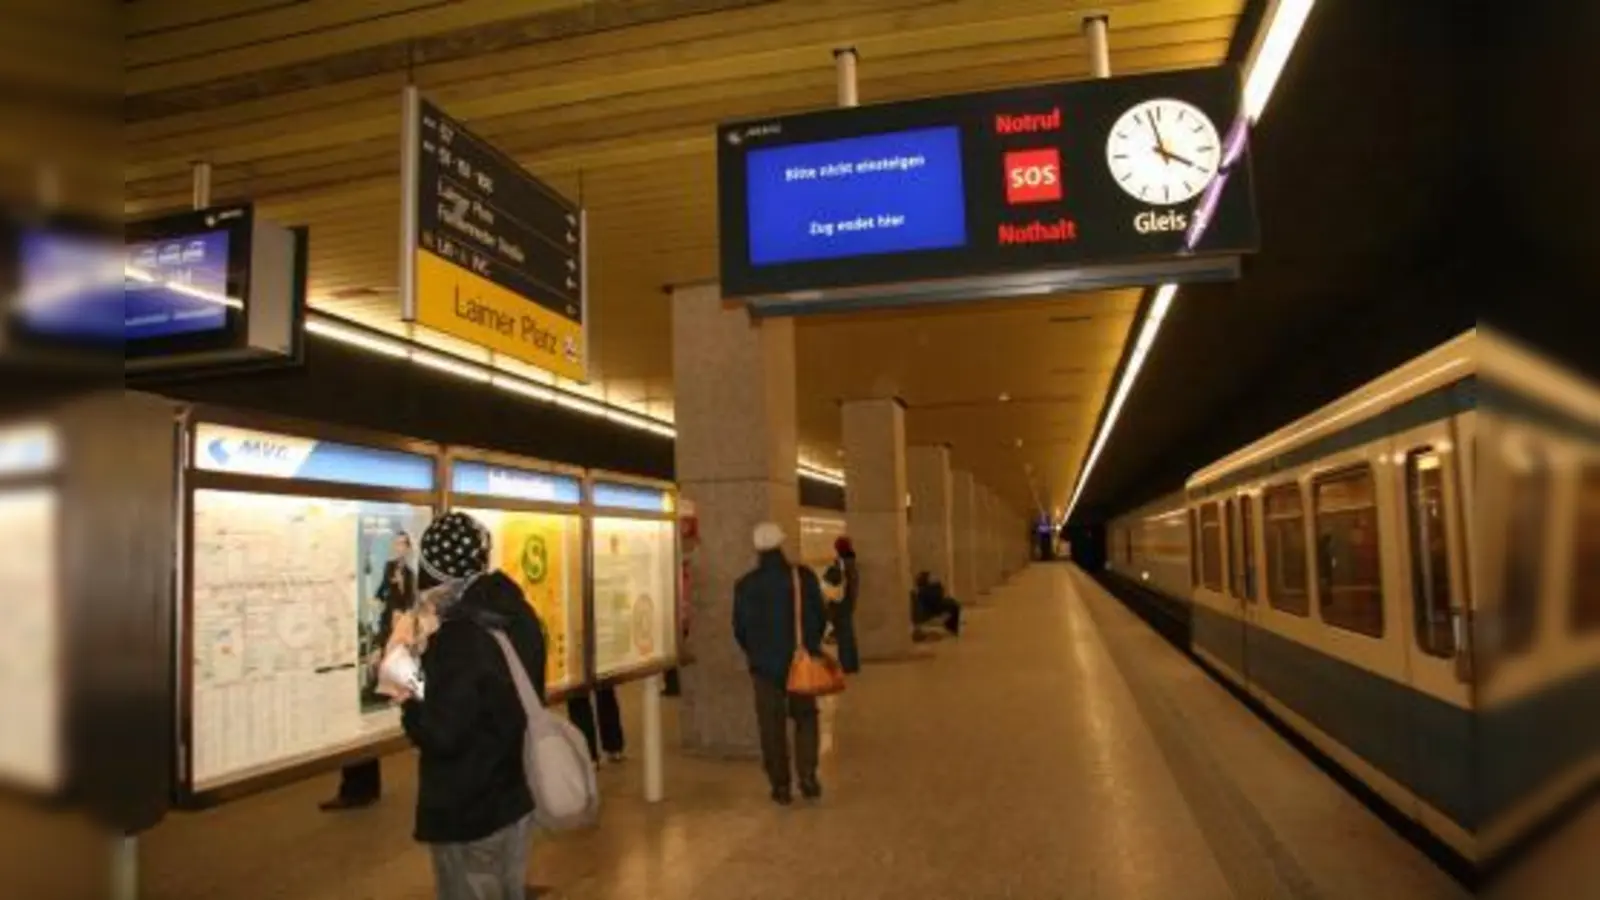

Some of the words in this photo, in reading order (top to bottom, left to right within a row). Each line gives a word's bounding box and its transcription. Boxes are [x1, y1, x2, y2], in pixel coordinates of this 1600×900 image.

[996, 106, 1061, 133] Notruf
[819, 161, 853, 178] nicht
[856, 154, 925, 174] einsteigen
[1012, 164, 1057, 188] SOS
[809, 221, 835, 237] Zug
[837, 214, 876, 231] endet
[877, 213, 906, 228] hier
[998, 218, 1077, 244] Nothalt
[1133, 209, 1187, 234] Gleis
[454, 283, 515, 335] Laimer
[520, 314, 557, 355] Platz
